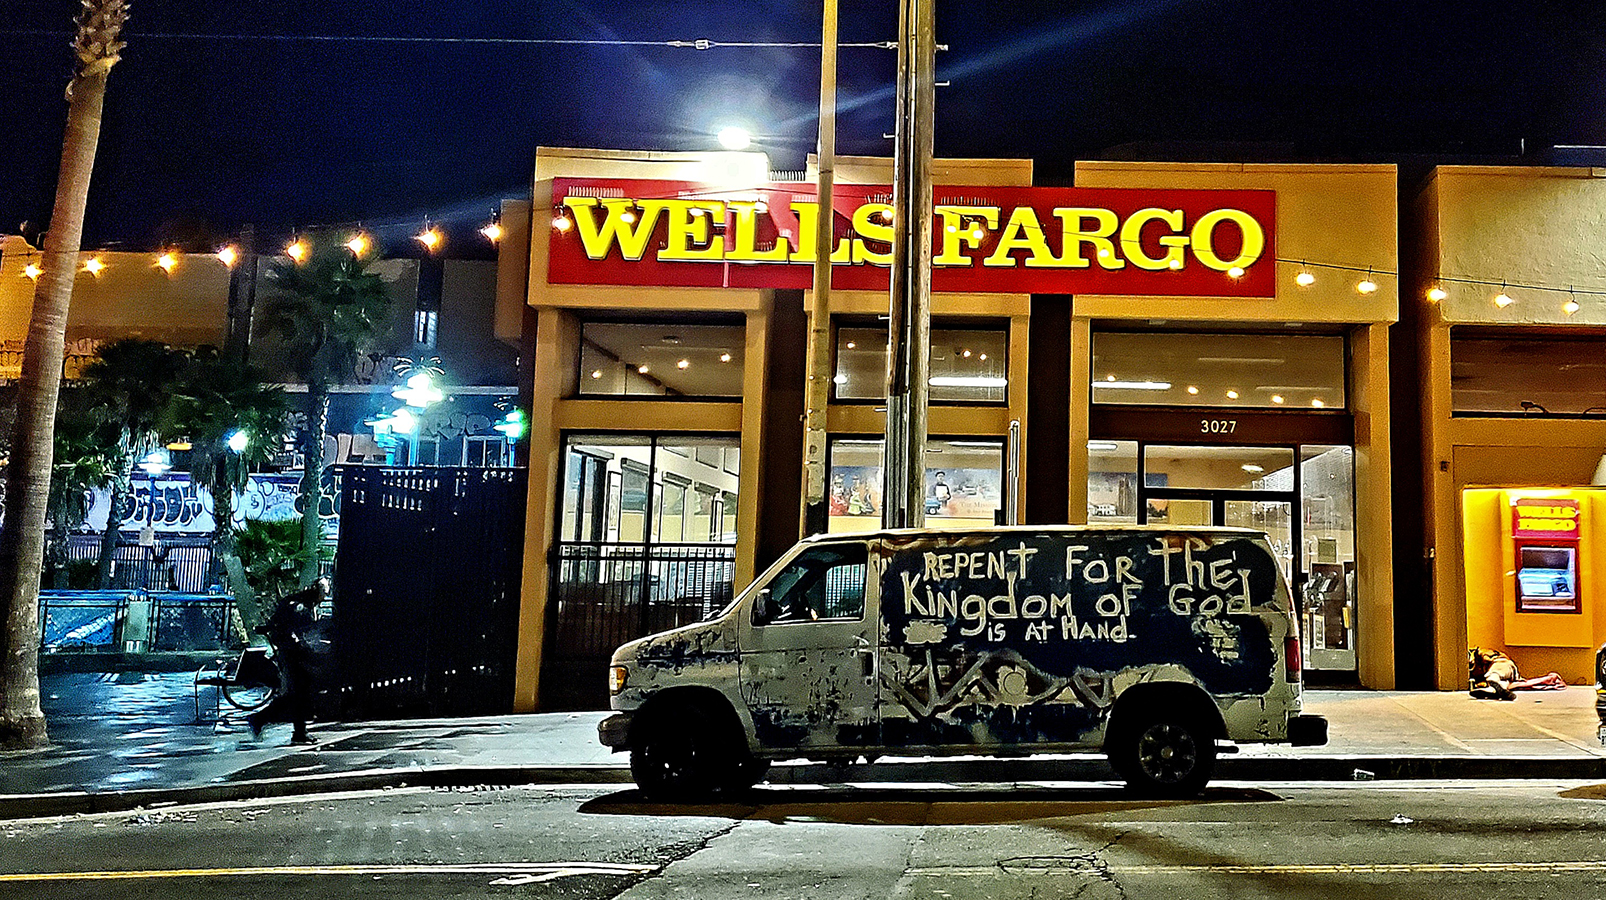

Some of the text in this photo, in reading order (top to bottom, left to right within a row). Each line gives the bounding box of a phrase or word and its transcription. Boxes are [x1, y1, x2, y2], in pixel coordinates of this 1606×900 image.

[563, 196, 1265, 273] WELLS FARGO
[1200, 420, 1237, 434] 3027
